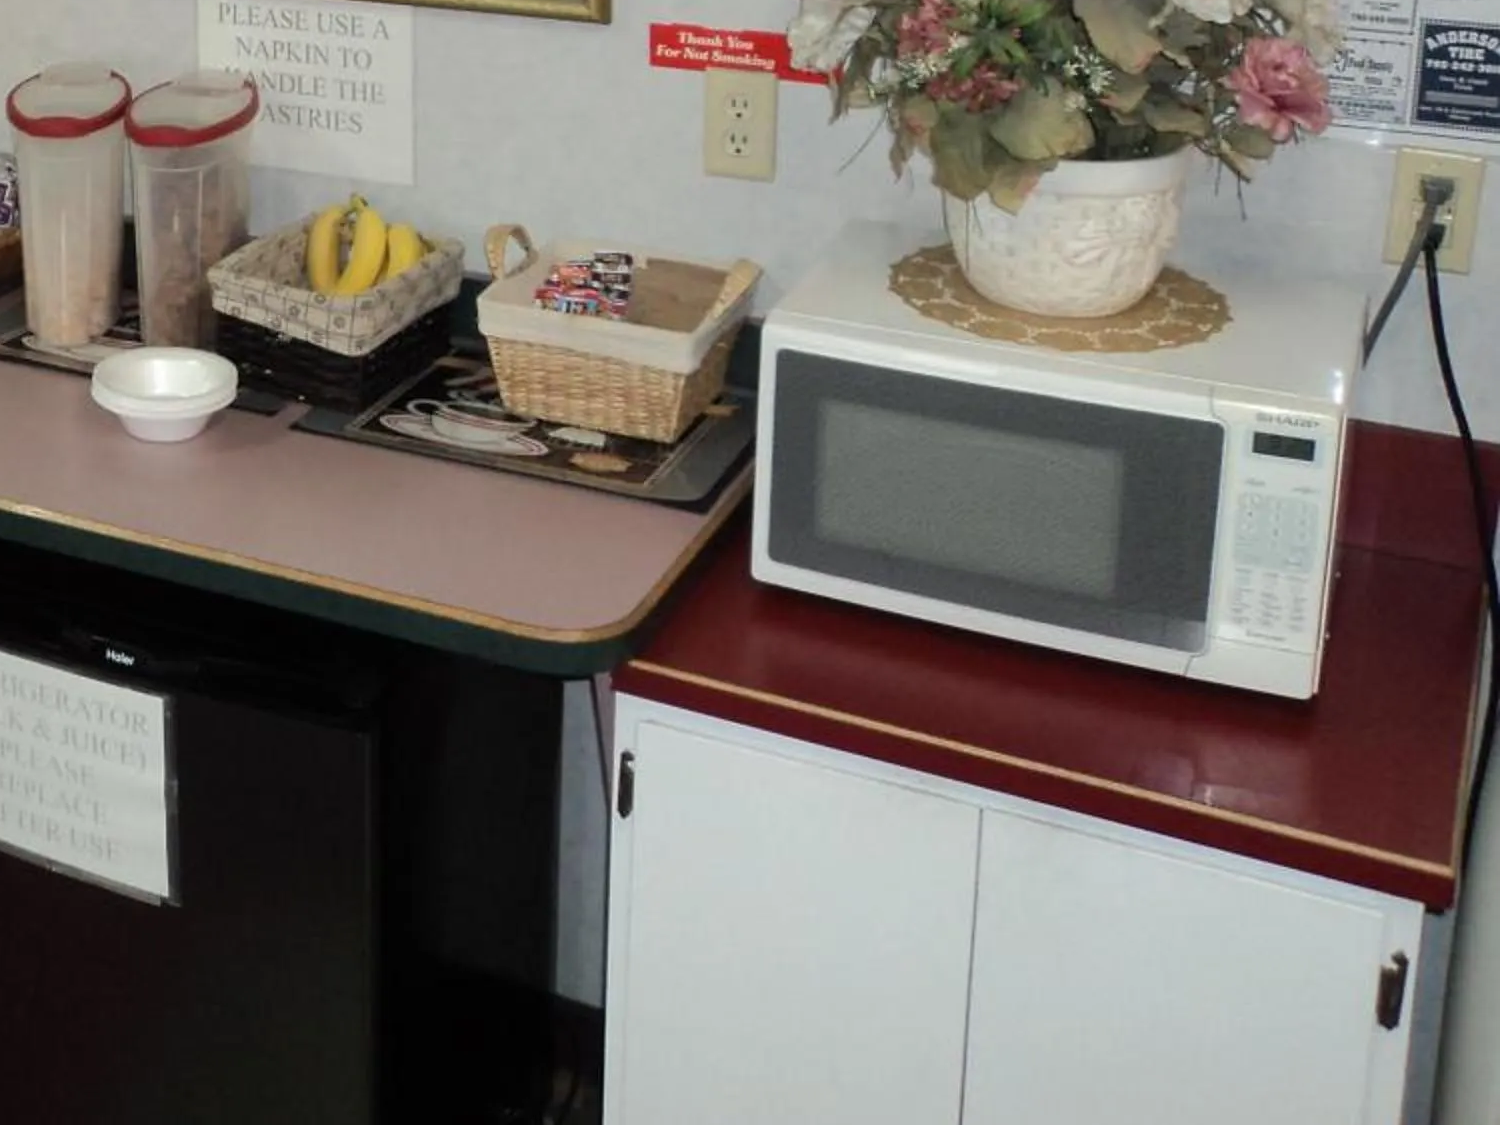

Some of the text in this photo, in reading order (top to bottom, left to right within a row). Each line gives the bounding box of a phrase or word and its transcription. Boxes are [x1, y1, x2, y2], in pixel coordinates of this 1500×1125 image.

[217, 1, 391, 42] PLEASE USE A
[236, 35, 373, 72] NAPKIN TO
[676, 31, 755, 51] Thank You
[656, 44, 776, 70] For Not Smoking
[332, 77, 387, 106] THE
[260, 103, 364, 135] ASTRIES
[105, 648, 136, 667] Haier
[32, 717, 51, 743] &
